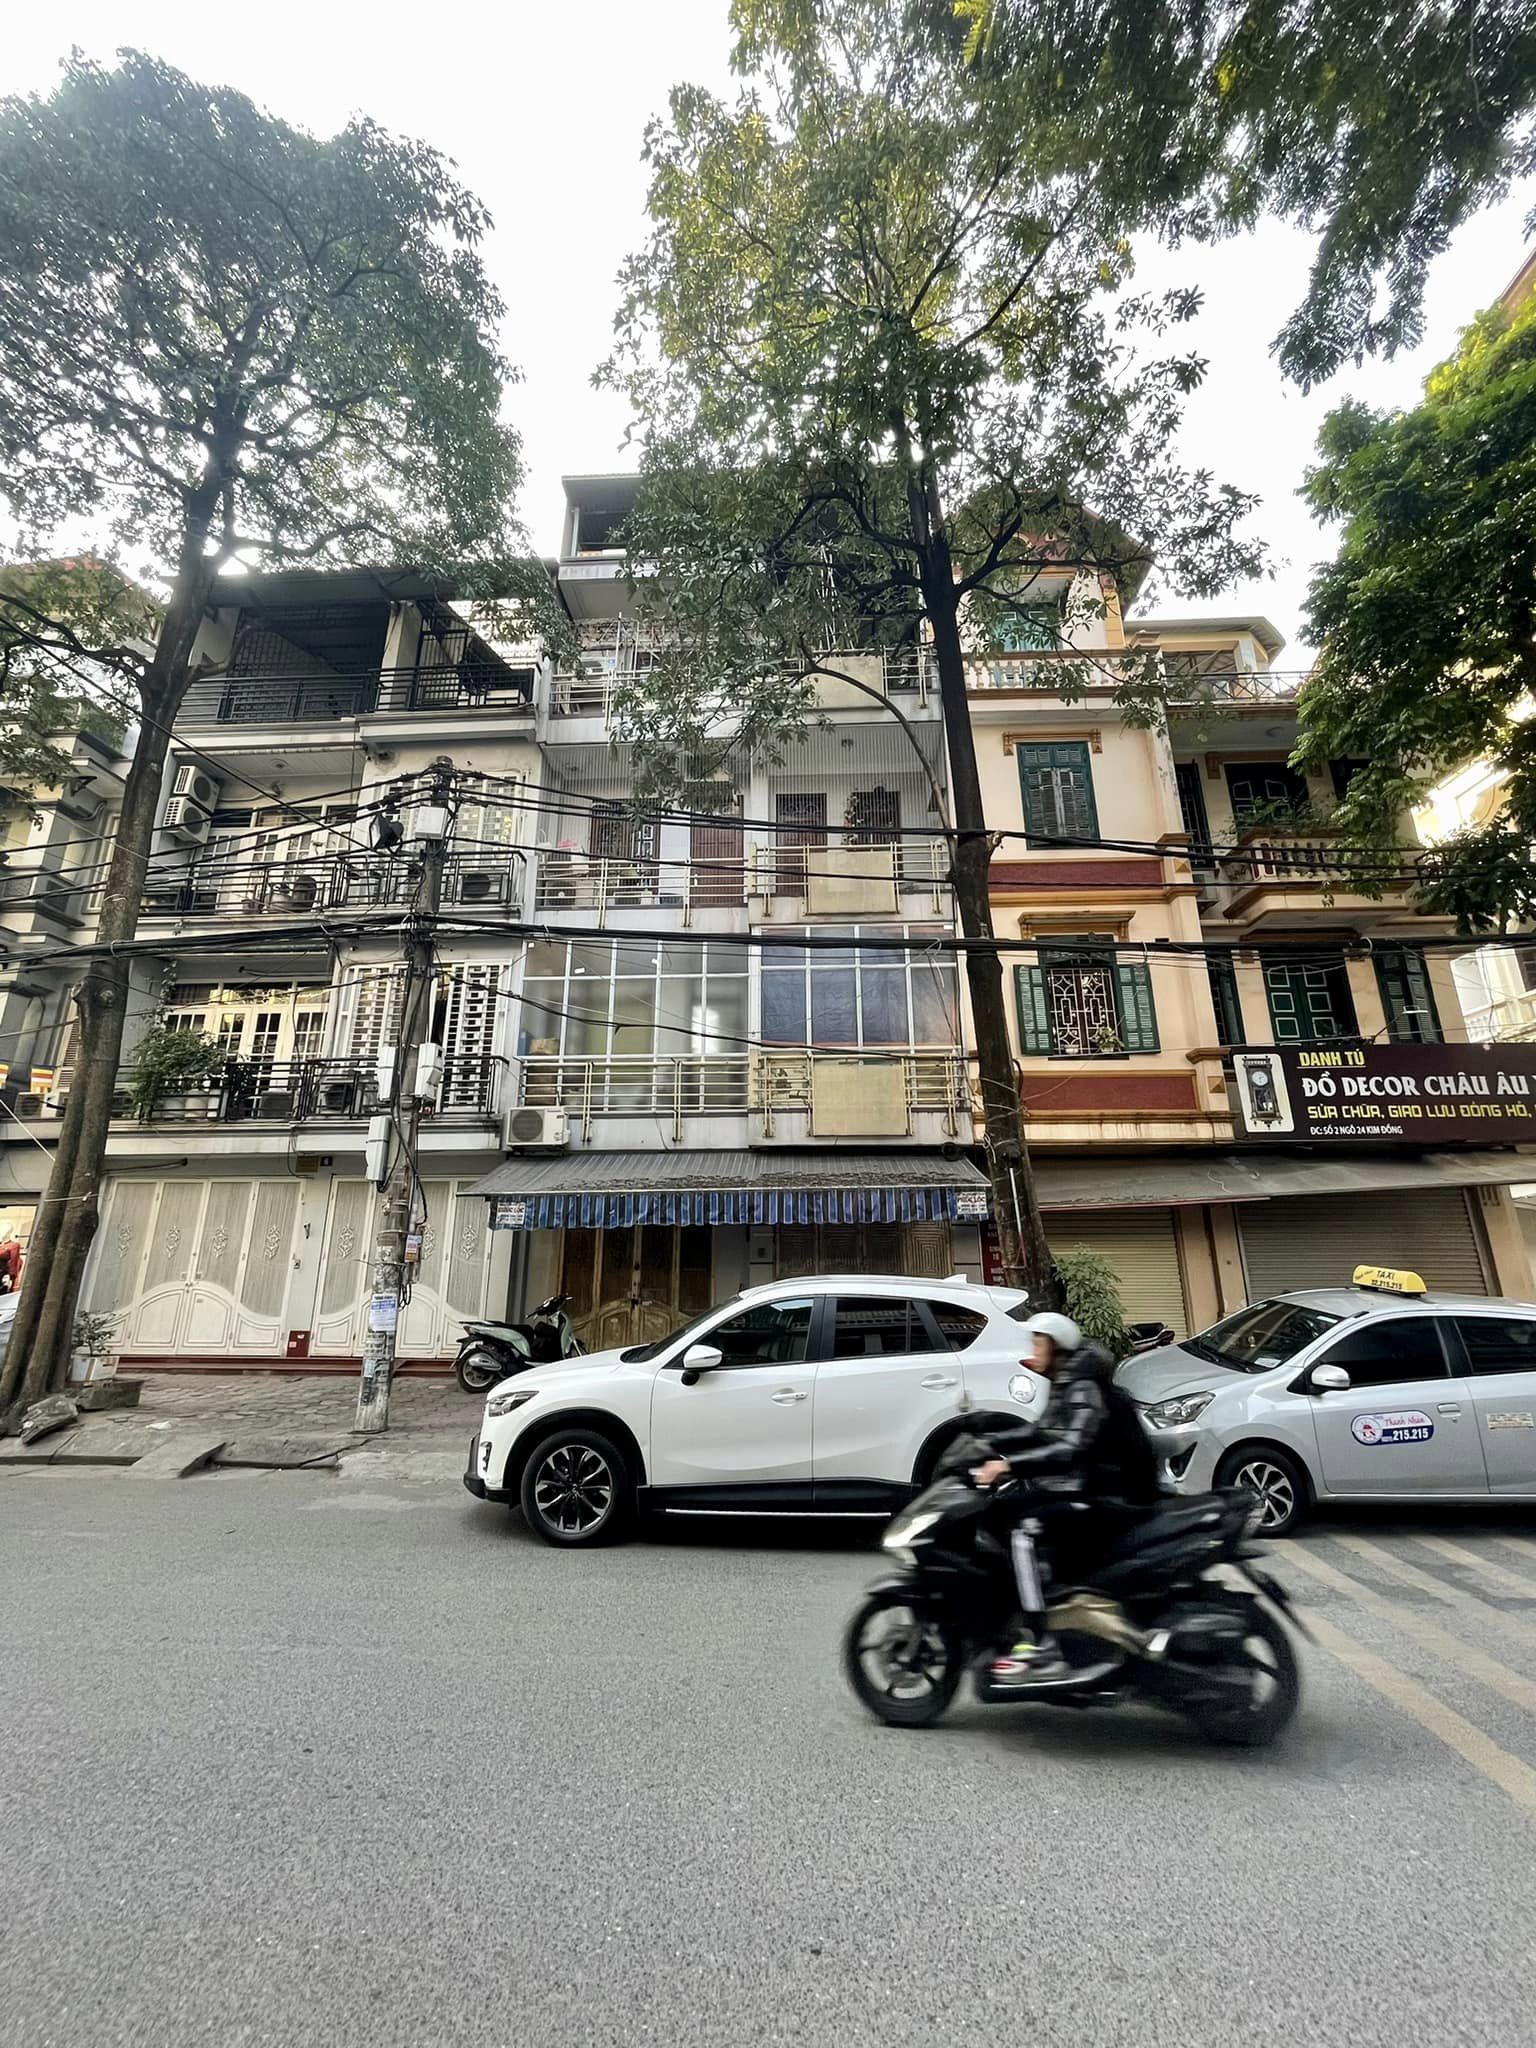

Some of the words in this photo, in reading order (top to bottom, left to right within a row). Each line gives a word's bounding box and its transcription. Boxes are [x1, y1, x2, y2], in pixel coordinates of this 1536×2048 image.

[1298, 1051, 1342, 1066] DANH
[1302, 1071, 1337, 1097] ĐỒ
[1341, 1076, 1420, 1097] DECOR
[1424, 1071, 1490, 1096] CHÂU
[1496, 1071, 1530, 1095] ÂU
[1388, 1105, 1422, 1118] GIAO
[1334, 1127, 1339, 1135] 2
[1357, 1126, 1366, 1135] 24
[1366, 1126, 1380, 1135] KIM
[1376, 1270, 1395, 1280] TAXI
[1393, 1428, 1429, 1441] 215.215
